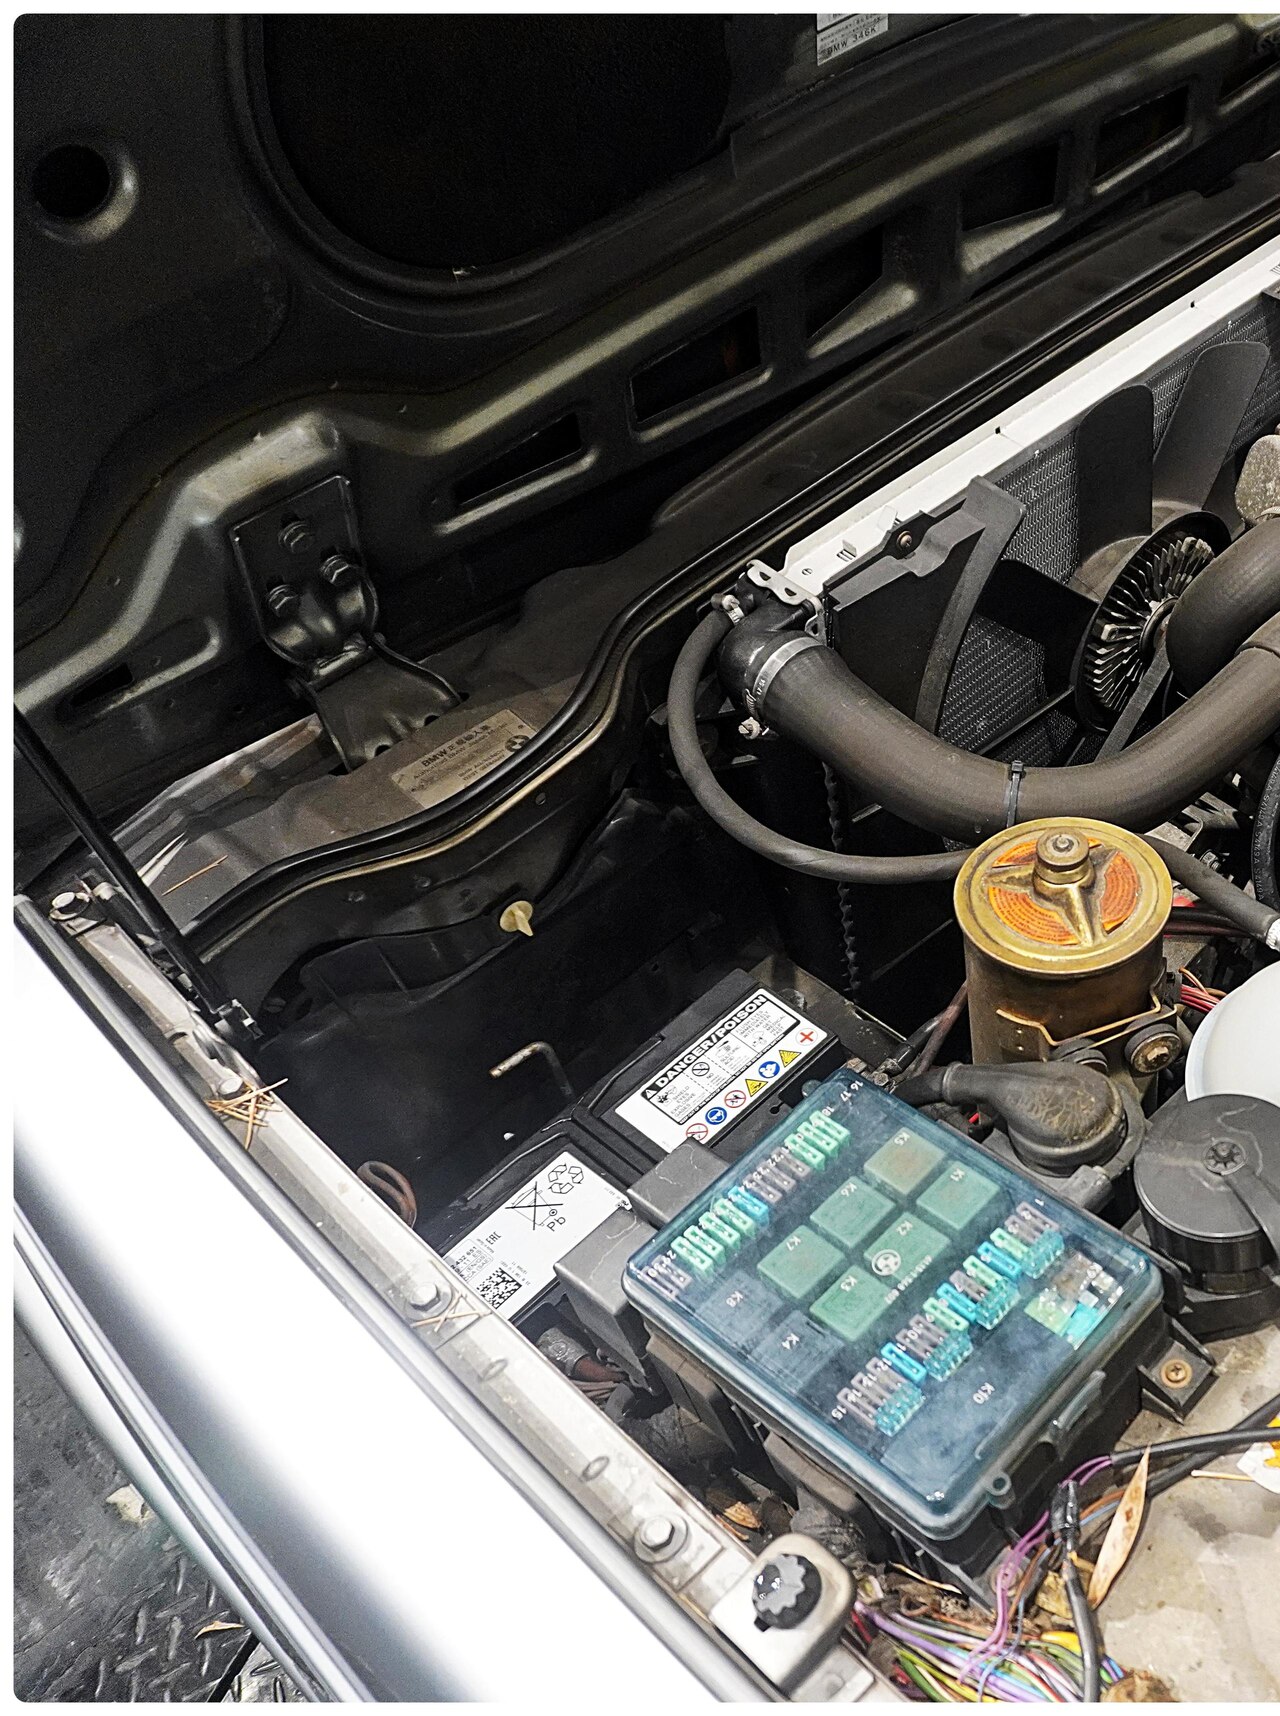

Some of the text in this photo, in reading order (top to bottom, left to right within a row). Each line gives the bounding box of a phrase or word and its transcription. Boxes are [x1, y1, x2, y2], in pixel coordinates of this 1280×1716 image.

[421, 748, 447, 767] BMW
[655, 994, 767, 1086] DANGER/POISON
[851, 1080, 864, 1091] 16
[676, 1091, 689, 1104] EYES
[840, 1092, 852, 1102] 17
[893, 1133, 910, 1147] K5
[766, 1152, 782, 1168] 22
[750, 1165, 766, 1181] 23
[949, 1168, 967, 1183] K1
[840, 1183, 858, 1198] K6
[546, 1215, 566, 1232] Pb
[896, 1220, 914, 1237] K2
[786, 1236, 802, 1251] K7
[660, 1248, 677, 1265] 29
[840, 1276, 859, 1293] K3
[726, 1290, 744, 1308] K8
[781, 1332, 800, 1350] K4
[905, 1324, 922, 1341] 10
[876, 1355, 893, 1372] 12
[972, 1381, 996, 1405] K10
[831, 1404, 847, 1421] 15
